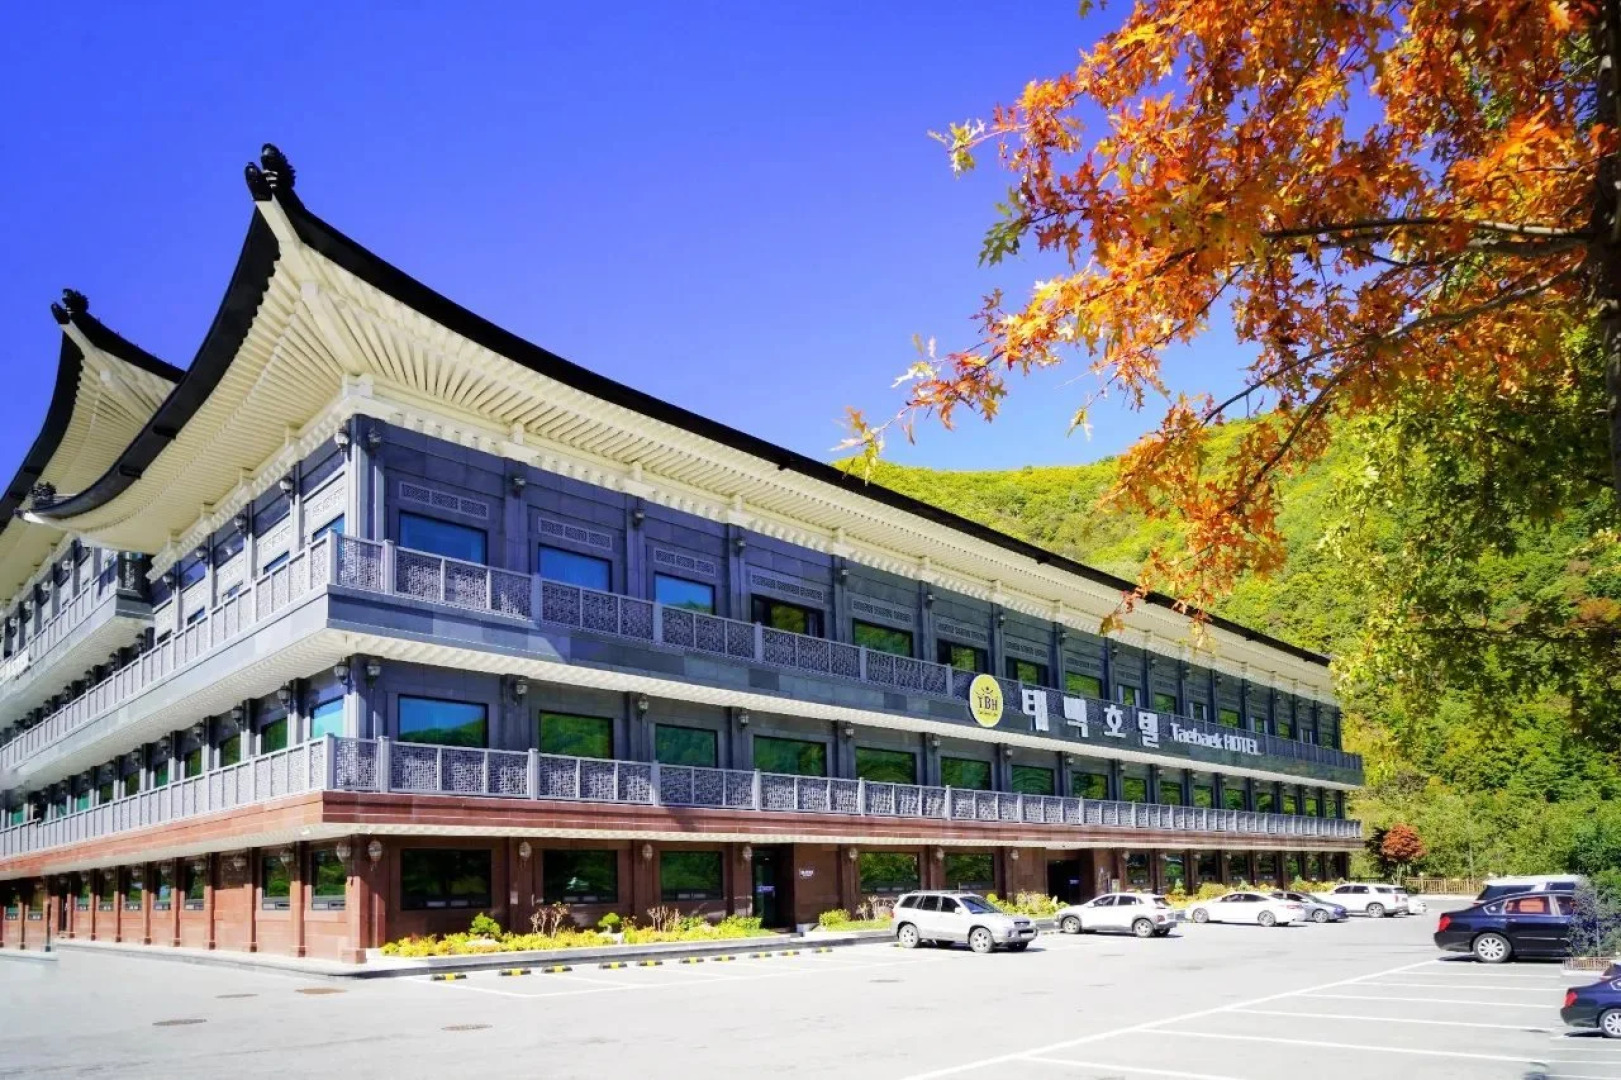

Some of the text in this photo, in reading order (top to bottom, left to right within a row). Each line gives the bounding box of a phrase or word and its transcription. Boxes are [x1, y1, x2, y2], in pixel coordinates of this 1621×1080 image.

[977, 695, 998, 711] TBH
[1021, 688, 1160, 749] 태백호텔
[1170, 722, 1264, 756] Taebaek HOTEL
